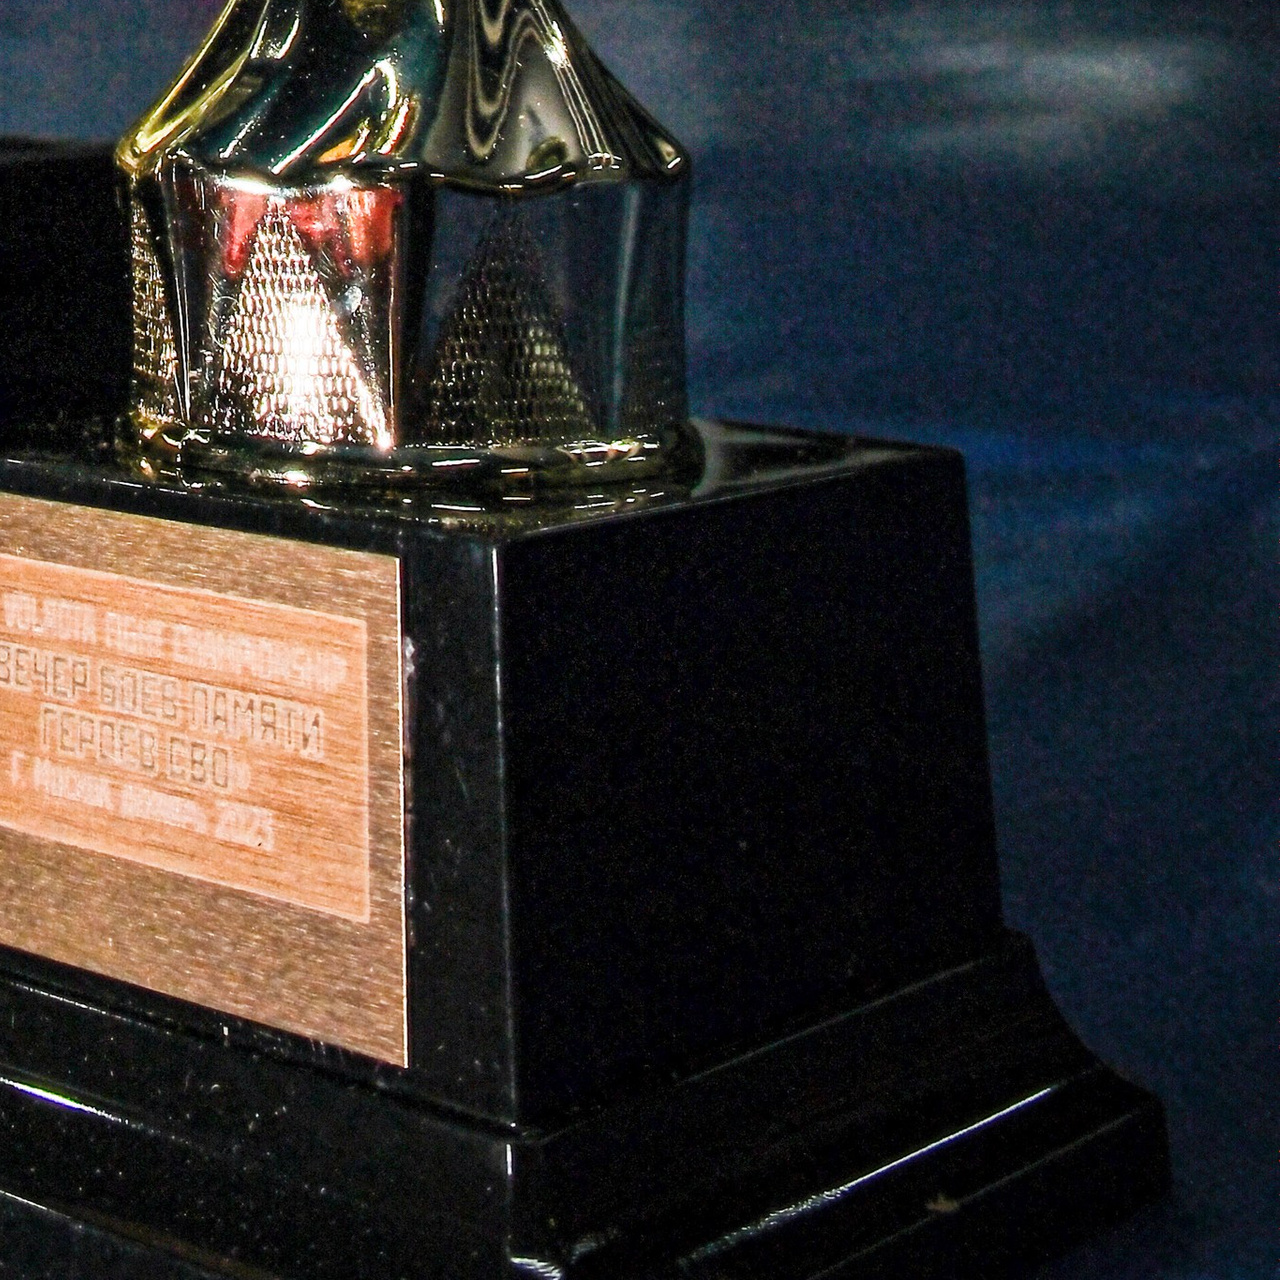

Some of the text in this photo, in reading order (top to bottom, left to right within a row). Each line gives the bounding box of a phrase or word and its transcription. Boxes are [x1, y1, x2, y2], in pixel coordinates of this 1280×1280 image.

[40, 703, 159, 776] ГЕРОЕВ
[99, 662, 181, 725] БОЕВ
[190, 683, 324, 759] ПАМЯТИ
